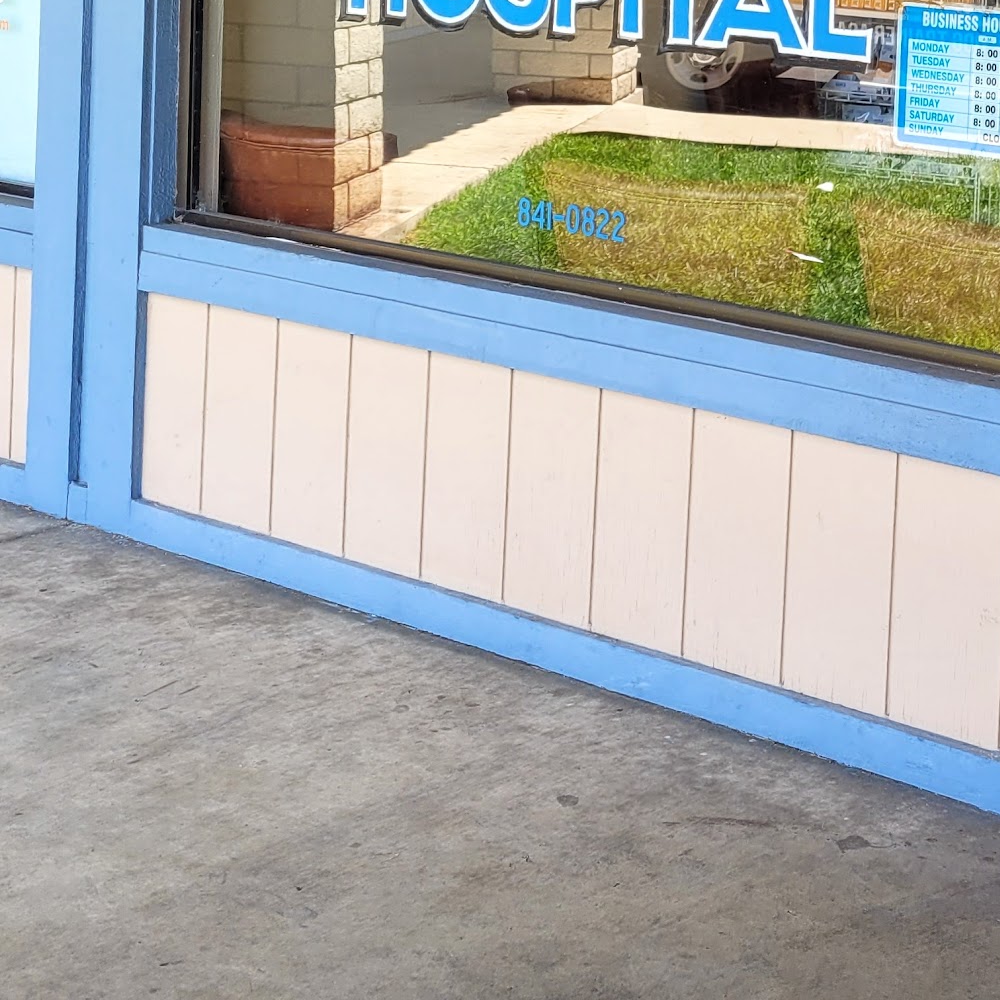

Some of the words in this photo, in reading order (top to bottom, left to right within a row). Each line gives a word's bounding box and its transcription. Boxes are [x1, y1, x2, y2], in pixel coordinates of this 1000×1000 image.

[922, 11, 979, 31] BUSINESS
[912, 41, 950, 53] MONDAY
[912, 55, 951, 67] TUESDAY
[911, 69, 965, 83] WEDNESDAY
[910, 82, 957, 96] THURSDAY
[909, 96, 941, 108] FRIDAY
[909, 111, 955, 124] SATURDAY
[908, 124, 944, 136] SUNDAY
[518, 197, 626, 243] 841-0822
